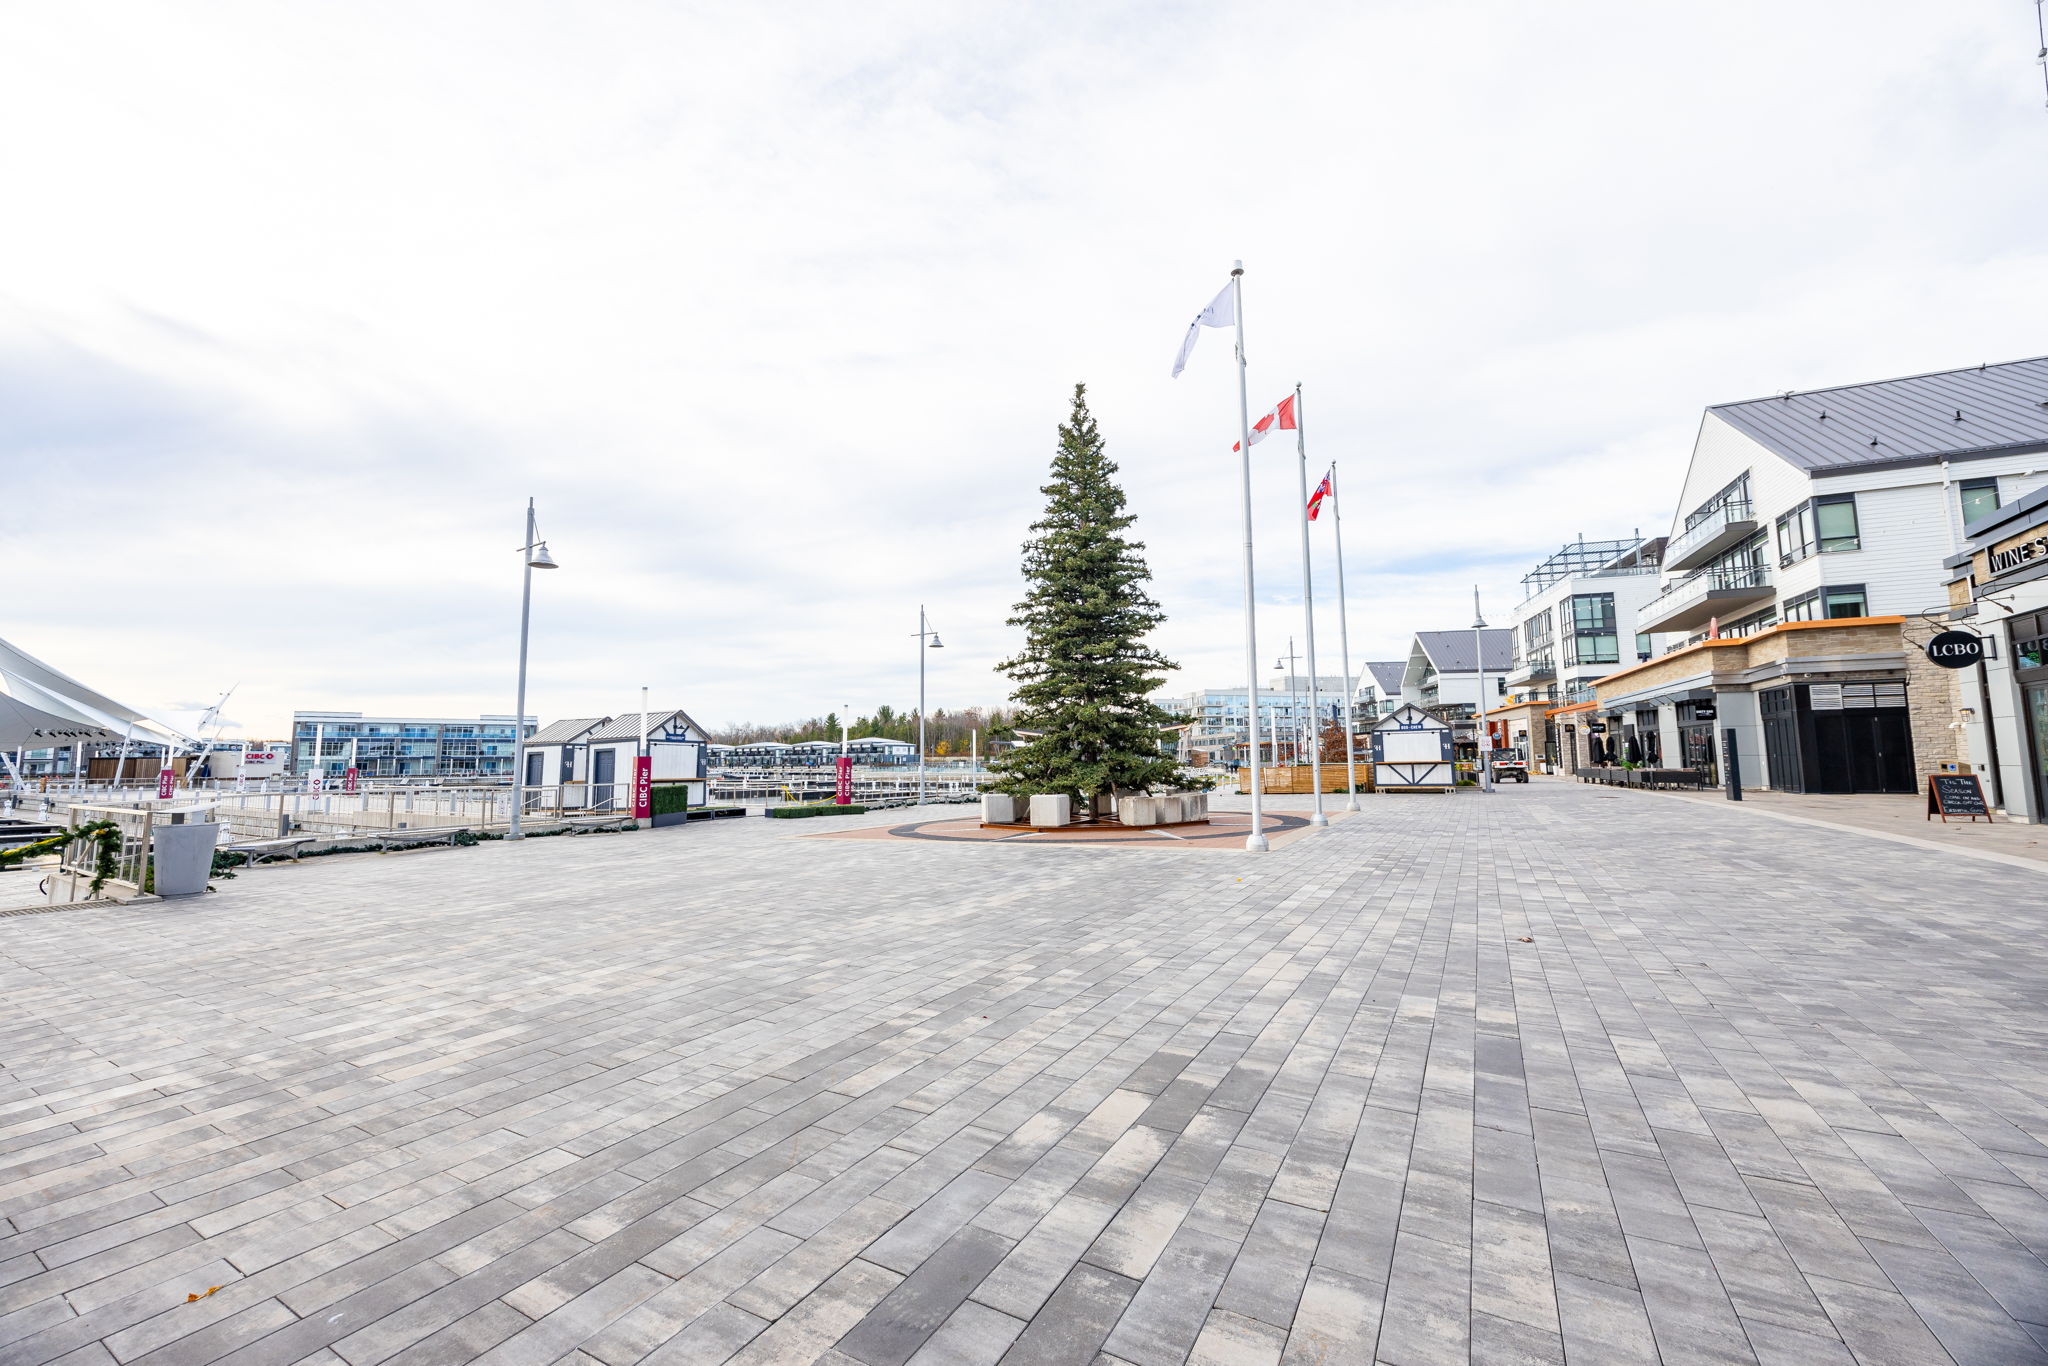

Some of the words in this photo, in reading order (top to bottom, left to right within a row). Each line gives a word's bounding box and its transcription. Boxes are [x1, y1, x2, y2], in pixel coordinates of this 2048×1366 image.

[1991, 543, 2030, 572] WINE
[2034, 537, 2048, 556] S
[1932, 642, 1979, 657] LCBO
[640, 768, 648, 784] Pier
[639, 787, 647, 807] CIBC
